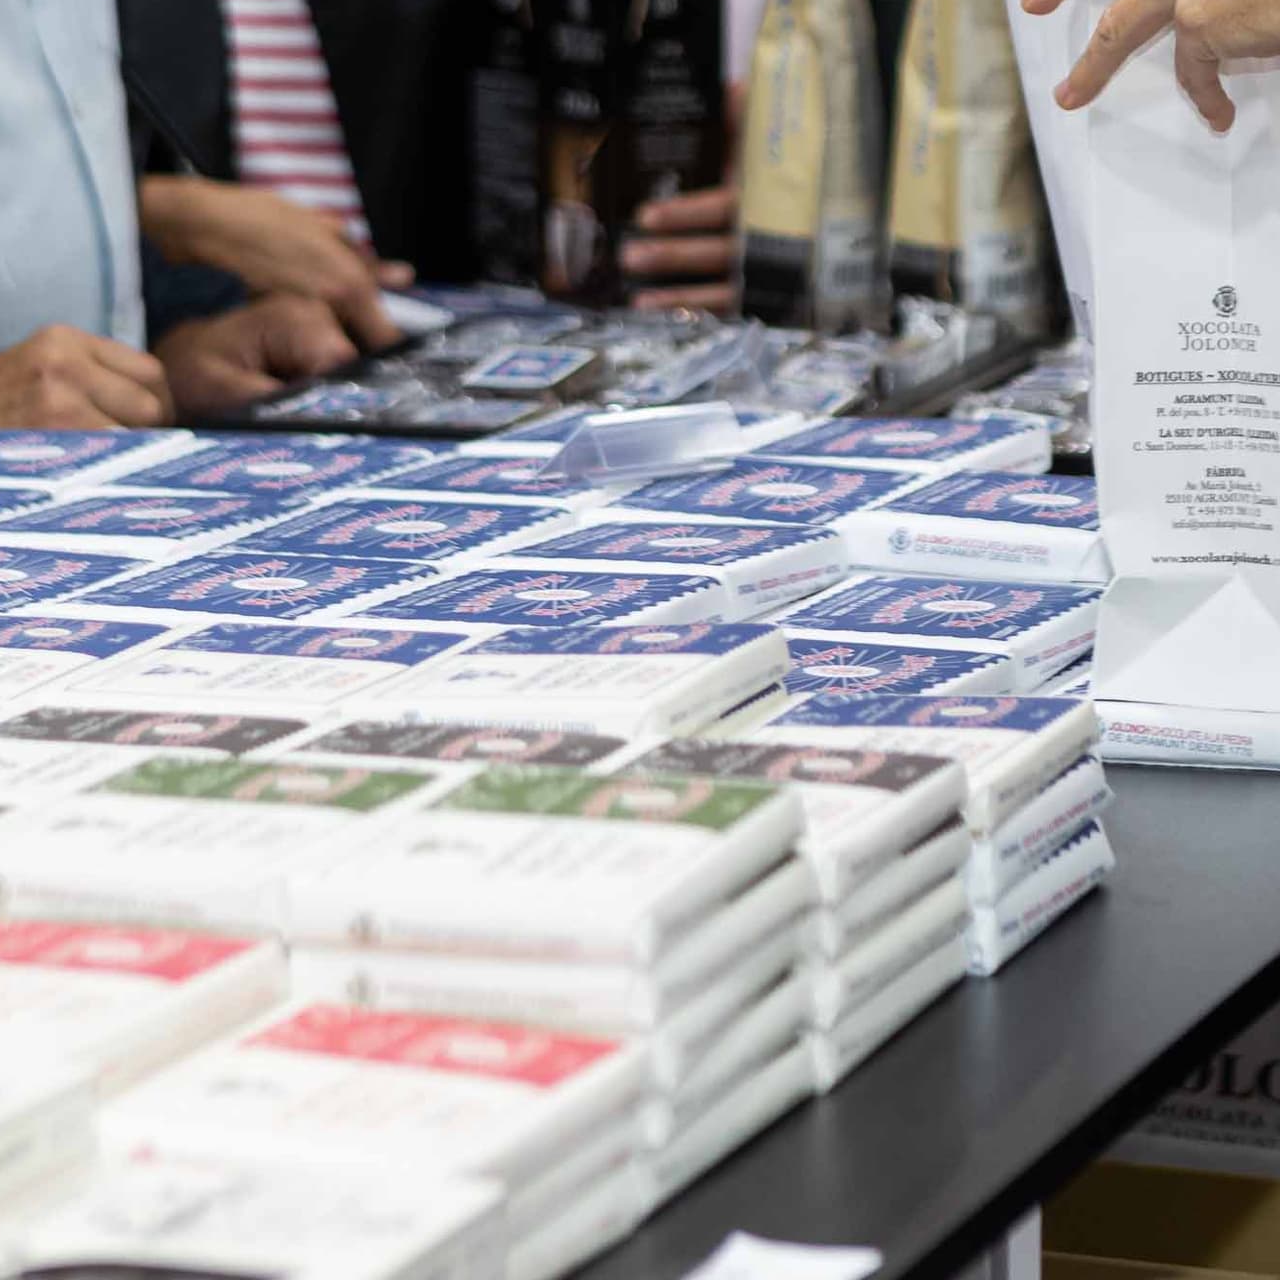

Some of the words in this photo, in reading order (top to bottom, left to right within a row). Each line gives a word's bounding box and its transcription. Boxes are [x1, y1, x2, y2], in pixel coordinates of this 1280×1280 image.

[1177, 321, 1262, 336] XOCOLATA
[1180, 336, 1258, 352] JOLONCH
[1135, 370, 1203, 382] BOTIGUES
[1174, 394, 1233, 405] AGRAMUNT
[1159, 428, 1172, 438] LA
[1174, 428, 1193, 438] SEU
